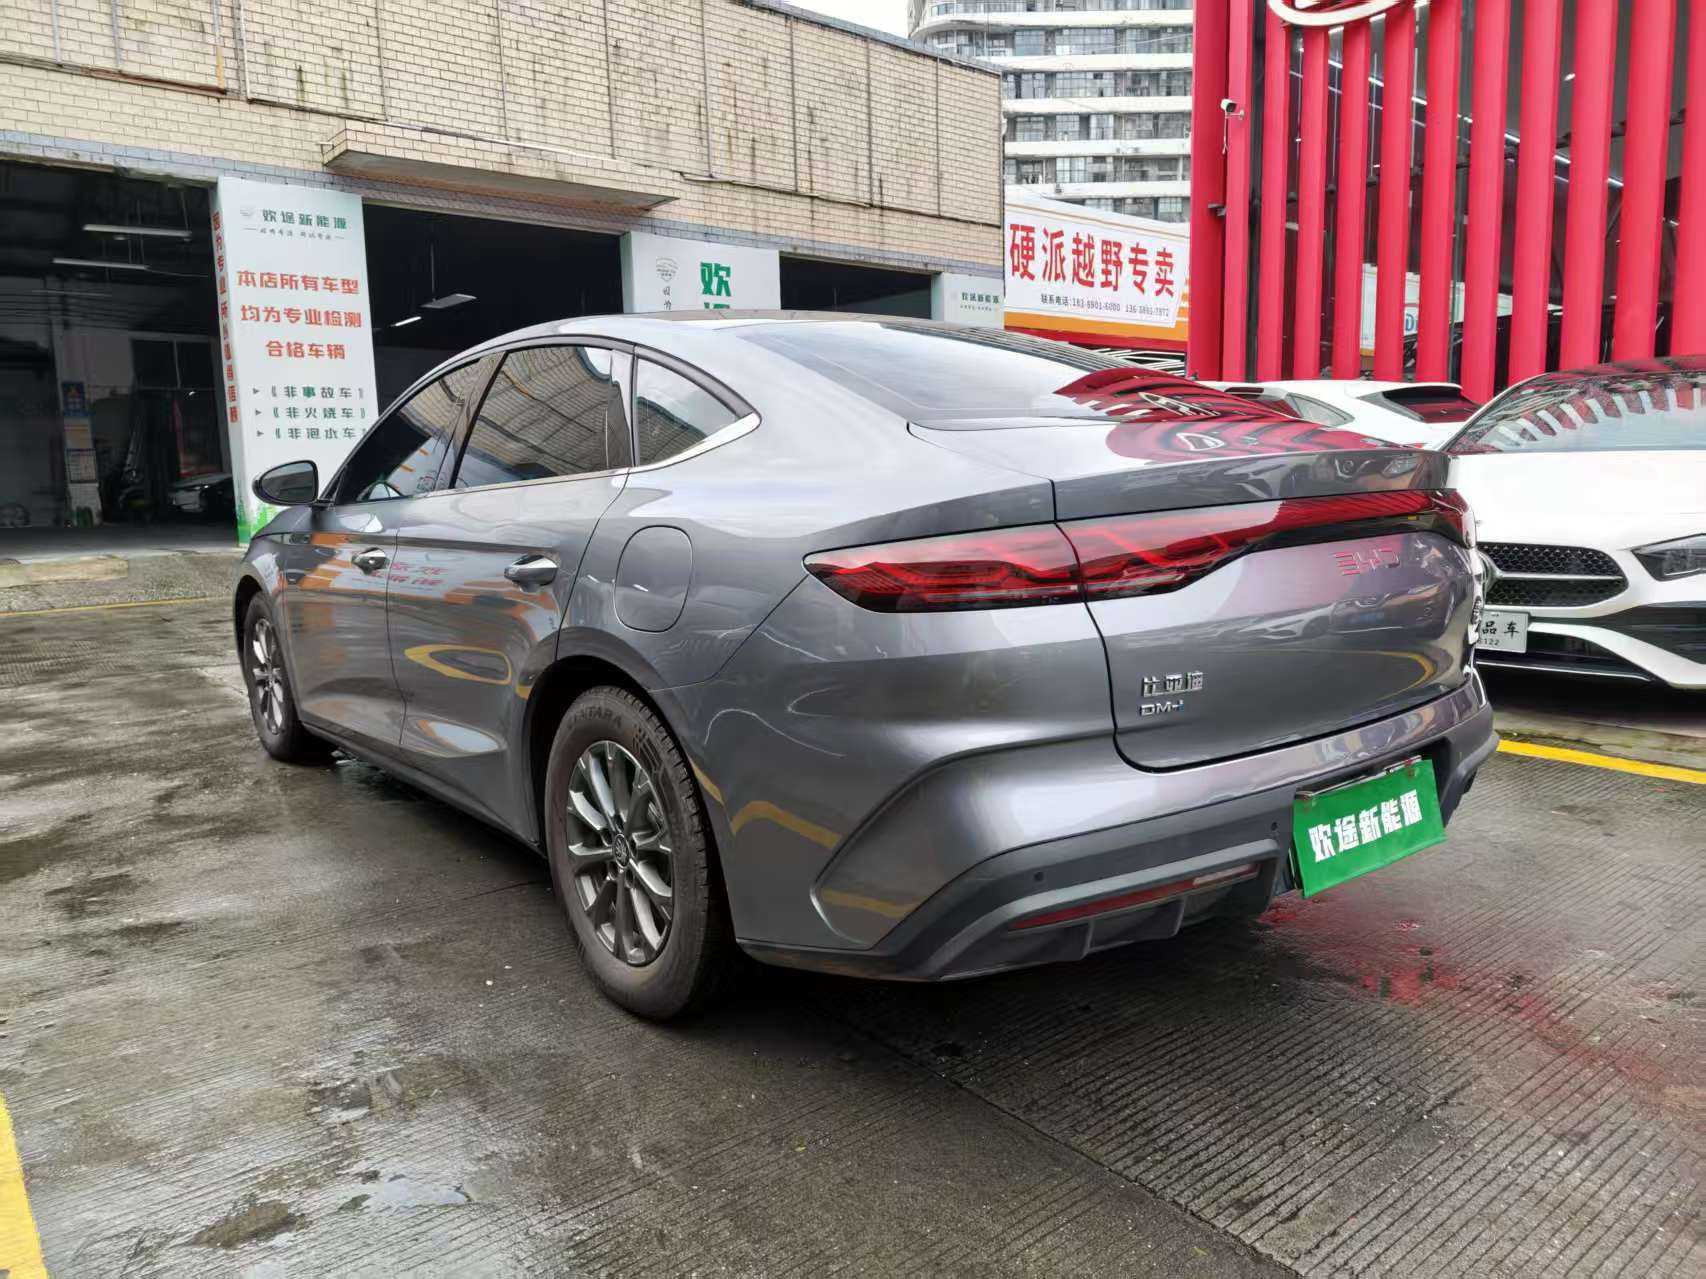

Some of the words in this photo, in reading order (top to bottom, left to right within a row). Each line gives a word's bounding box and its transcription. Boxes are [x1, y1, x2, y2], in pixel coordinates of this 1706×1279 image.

[1009, 223, 1174, 298] 硬派越野专卖
[237, 270, 360, 294] 本店所有车型
[240, 304, 362, 328] 均为专业检测
[266, 340, 345, 360] 合格车辆
[1476, 620, 1519, 639] 品车
[1308, 789, 1423, 863] 欢途新能源
